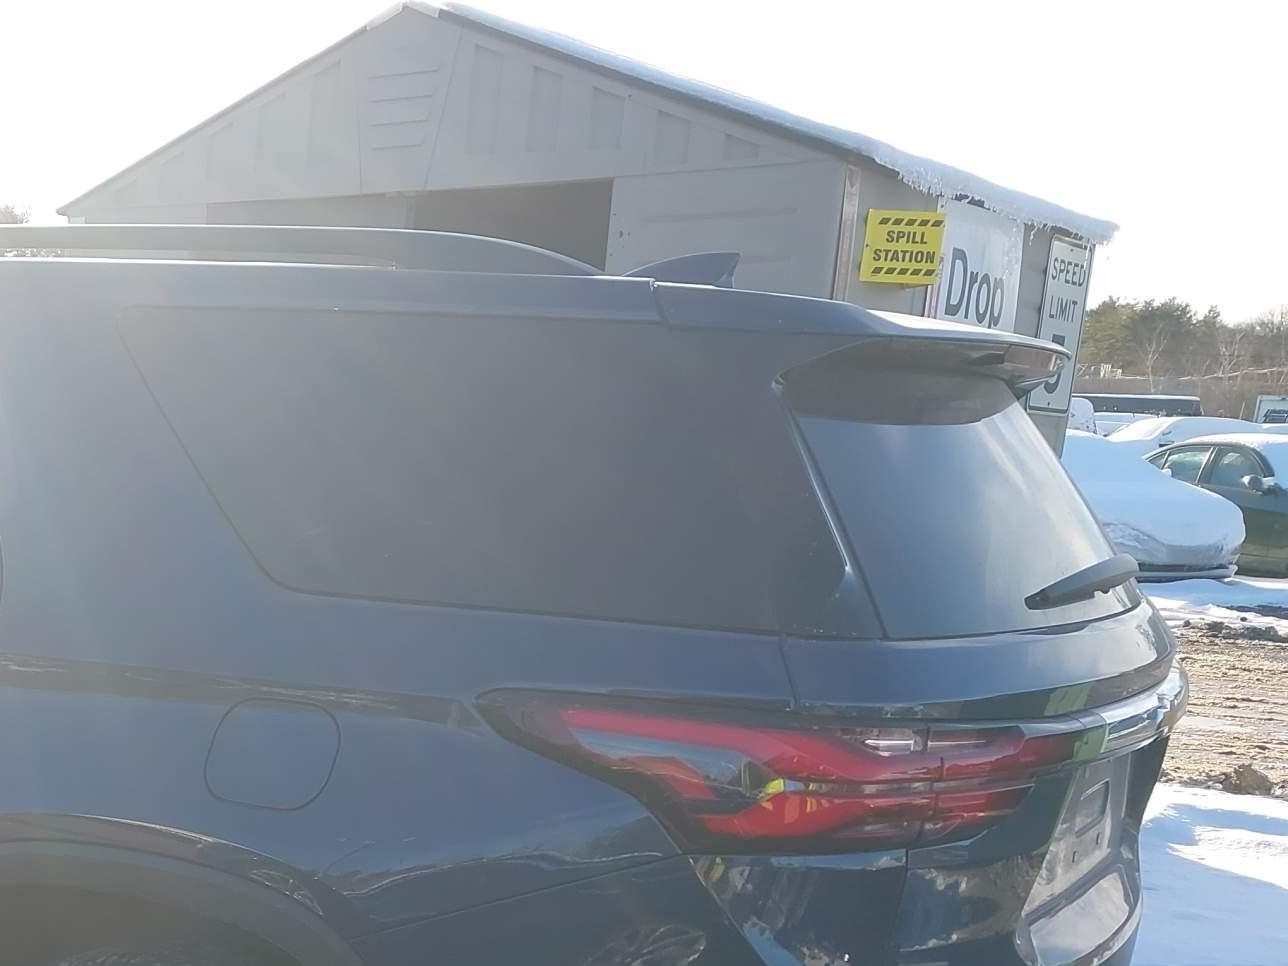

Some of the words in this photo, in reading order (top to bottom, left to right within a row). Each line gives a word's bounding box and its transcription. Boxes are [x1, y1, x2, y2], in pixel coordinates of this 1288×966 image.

[885, 230, 928, 245] SPILL
[872, 248, 935, 264] STATION
[1051, 257, 1087, 287] SPEED
[944, 247, 1005, 329] Drop
[1048, 295, 1078, 323] LIMIT
